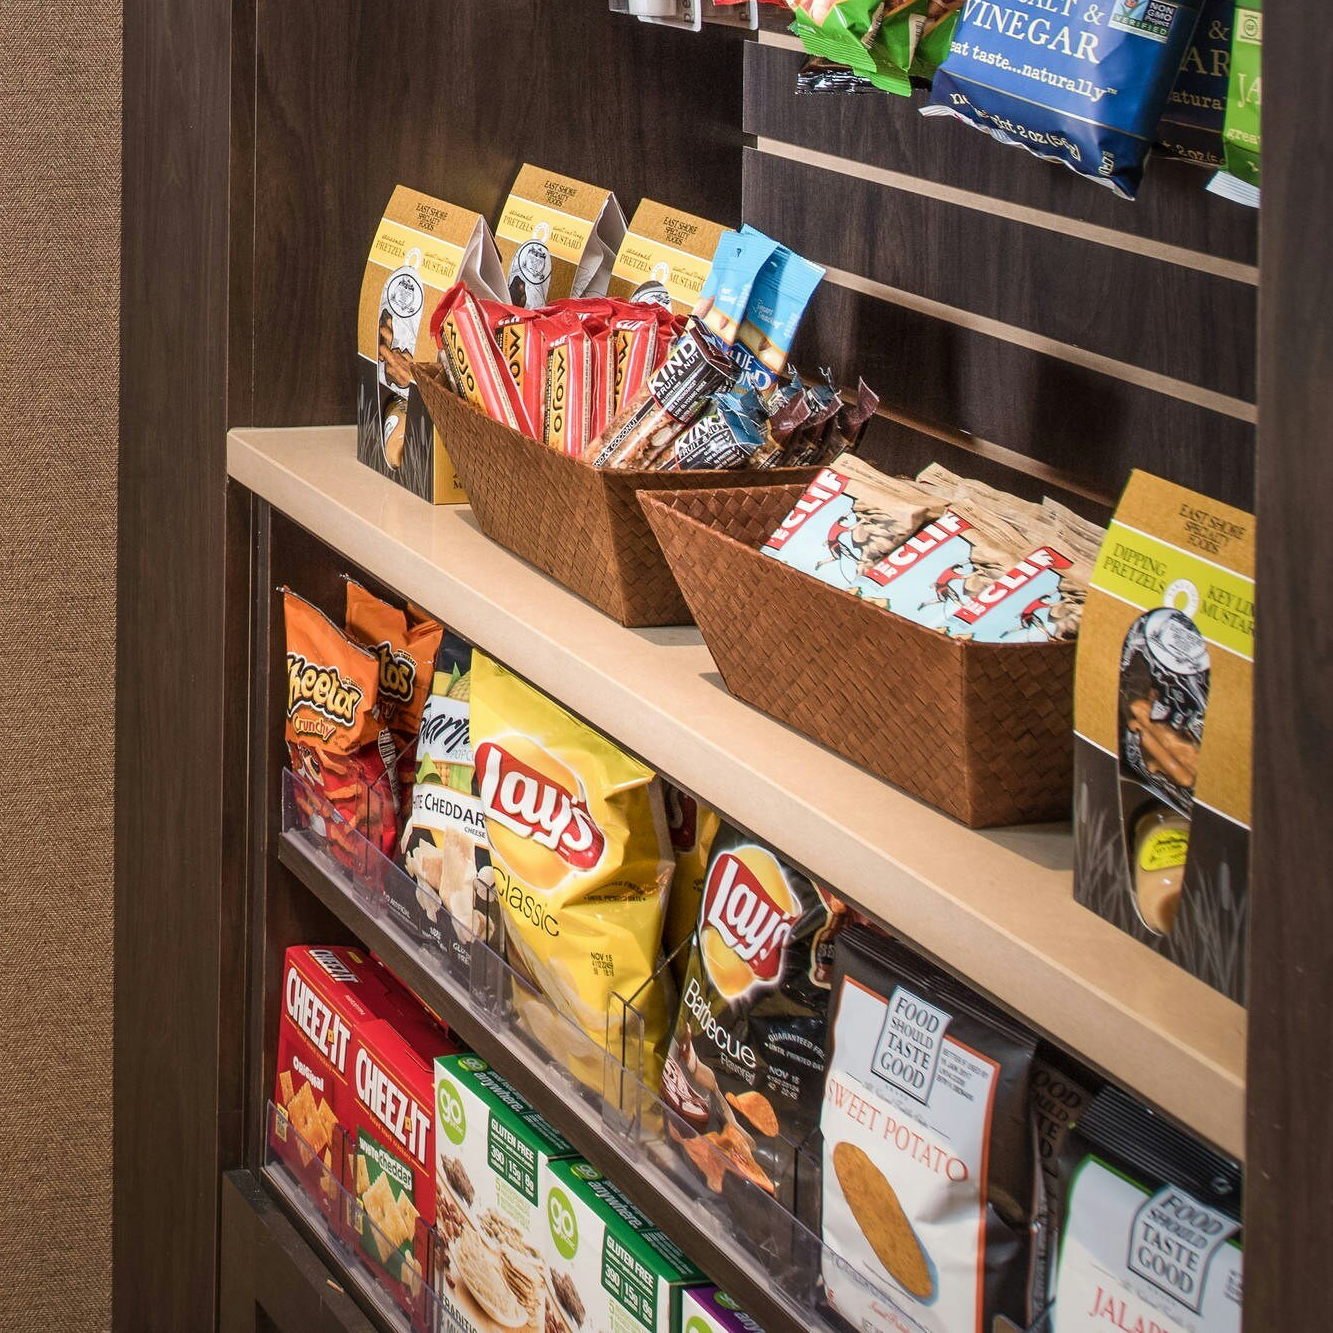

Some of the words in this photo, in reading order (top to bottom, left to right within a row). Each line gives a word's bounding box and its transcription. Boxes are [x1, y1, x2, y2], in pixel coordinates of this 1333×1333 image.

[1083, 4, 1105, 26] &
[375, 240, 406, 259] PRETZELS
[422, 258, 455, 278] MUSTARD
[648, 339, 698, 394] KIND
[656, 374, 678, 399] FRUIT
[685, 352, 700, 369] NUT
[888, 510, 970, 568] CLIF
[1113, 542, 1168, 578] DIPPING
[978, 547, 1061, 604] CLIF
[1103, 555, 1167, 595] PRETZELS
[293, 714, 336, 740] Crunchy
[424, 792, 486, 829] CHEDDAR
[482, 745, 593, 852] Lay's
[490, 866, 560, 937] Classic
[707, 857, 793, 962] Lay's
[590, 952, 602, 960] NOV
[683, 977, 758, 1068] Barbecue
[891, 1017, 934, 1050] SHOULD
[894, 996, 941, 1035] FOOD
[880, 1052, 926, 1091] GOOD
[887, 1031, 931, 1070] TASTE
[826, 1078, 882, 1132] SWEET
[883, 1116, 969, 1183] POTATO
[1159, 1192, 1224, 1237] FOOD
[1142, 1220, 1200, 1273] TASTE
[1137, 1245, 1195, 1295] GOOD
